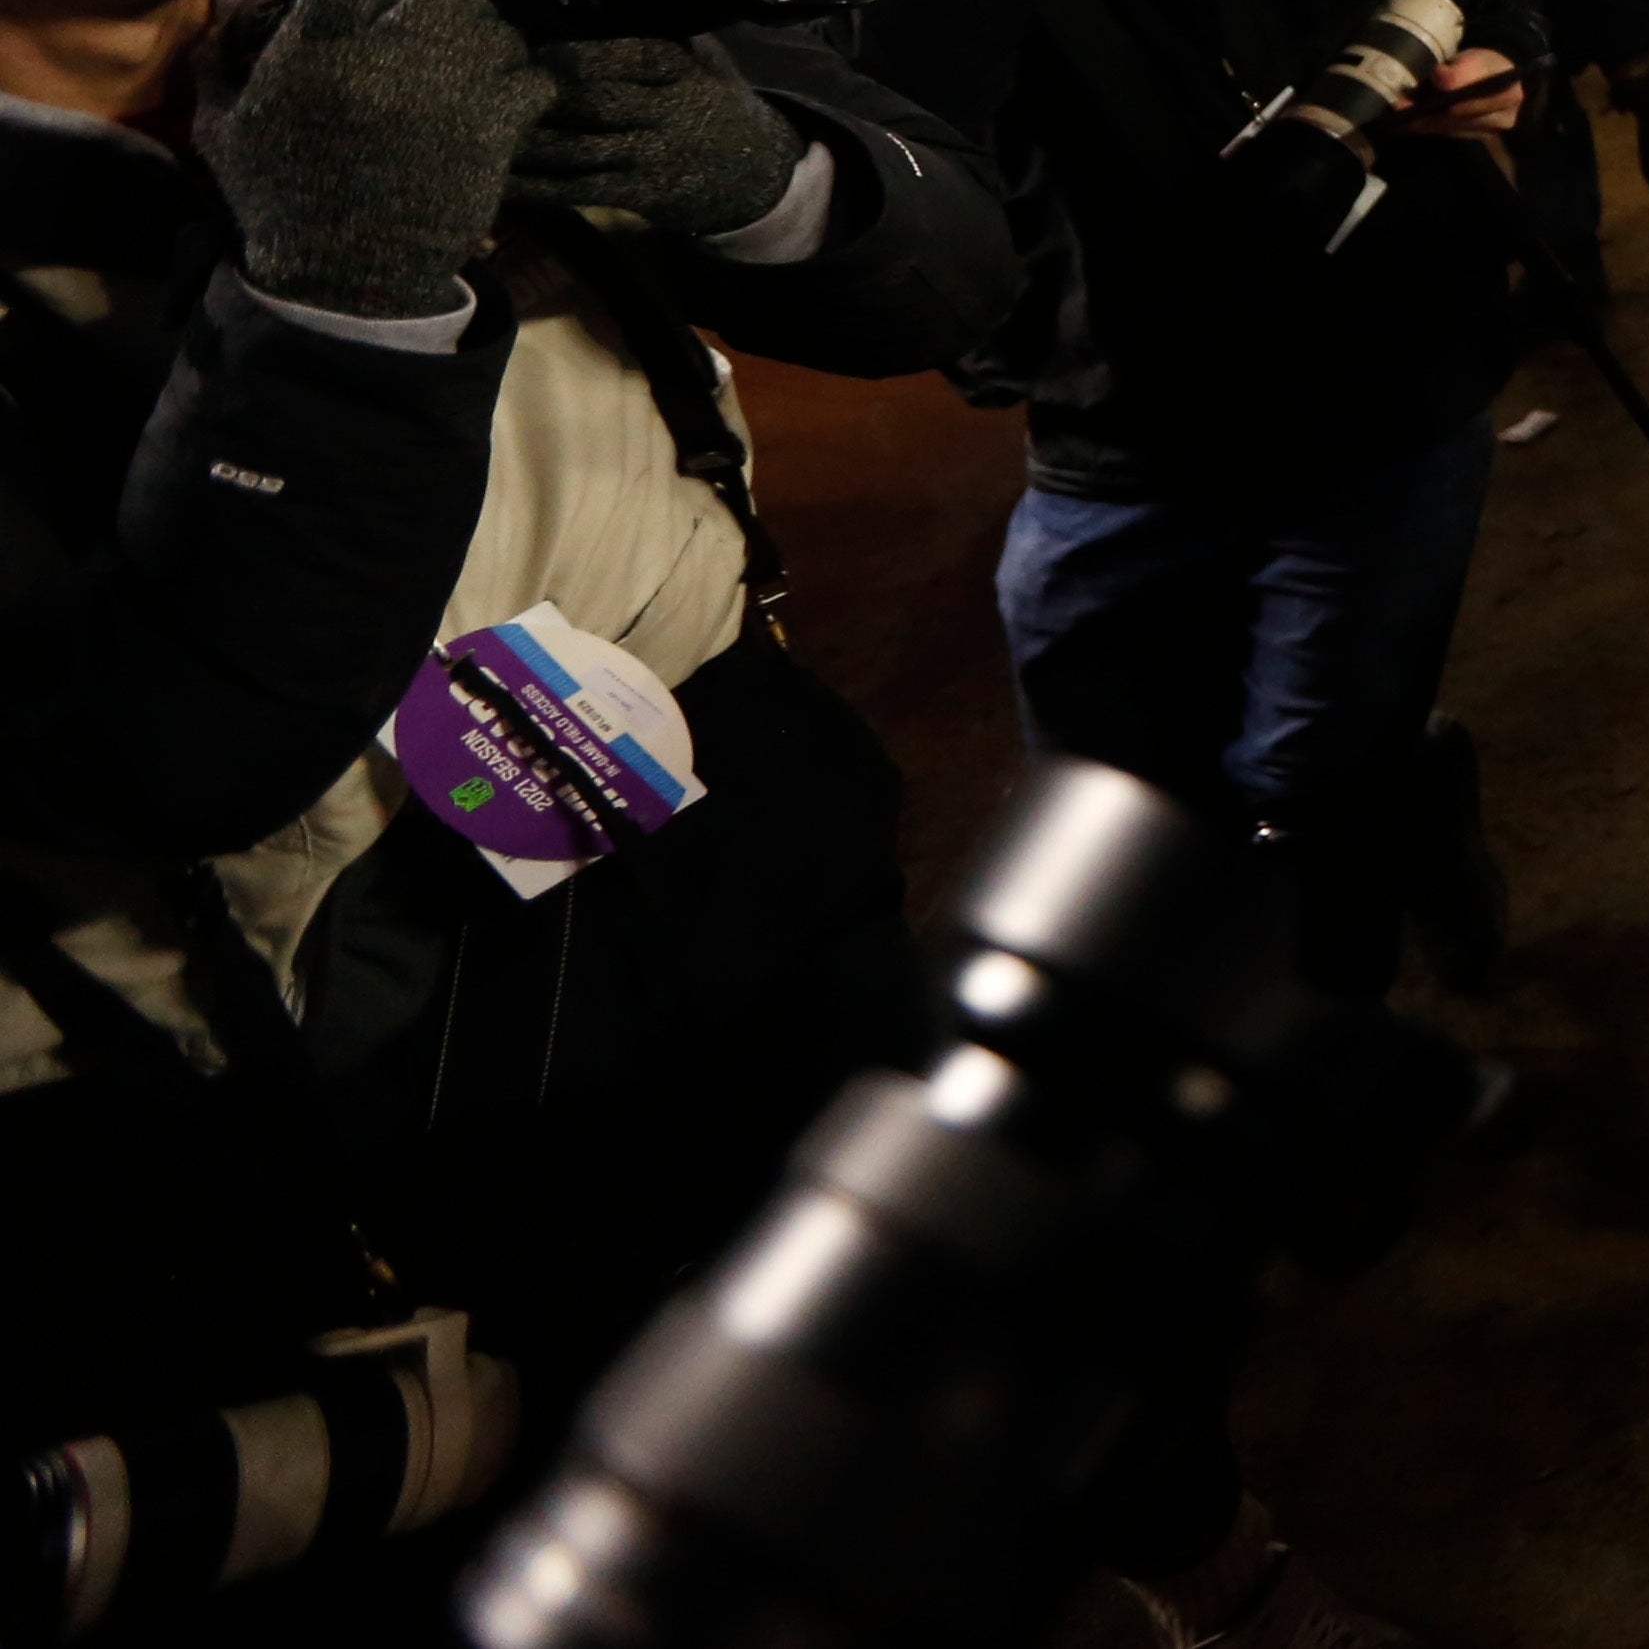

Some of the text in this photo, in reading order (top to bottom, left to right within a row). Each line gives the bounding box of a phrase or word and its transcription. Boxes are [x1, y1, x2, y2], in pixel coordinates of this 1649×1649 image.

[519, 683, 562, 721] ACCESS
[554, 717, 586, 744] FIELD
[460, 726, 555, 813] 2021 SEASON
